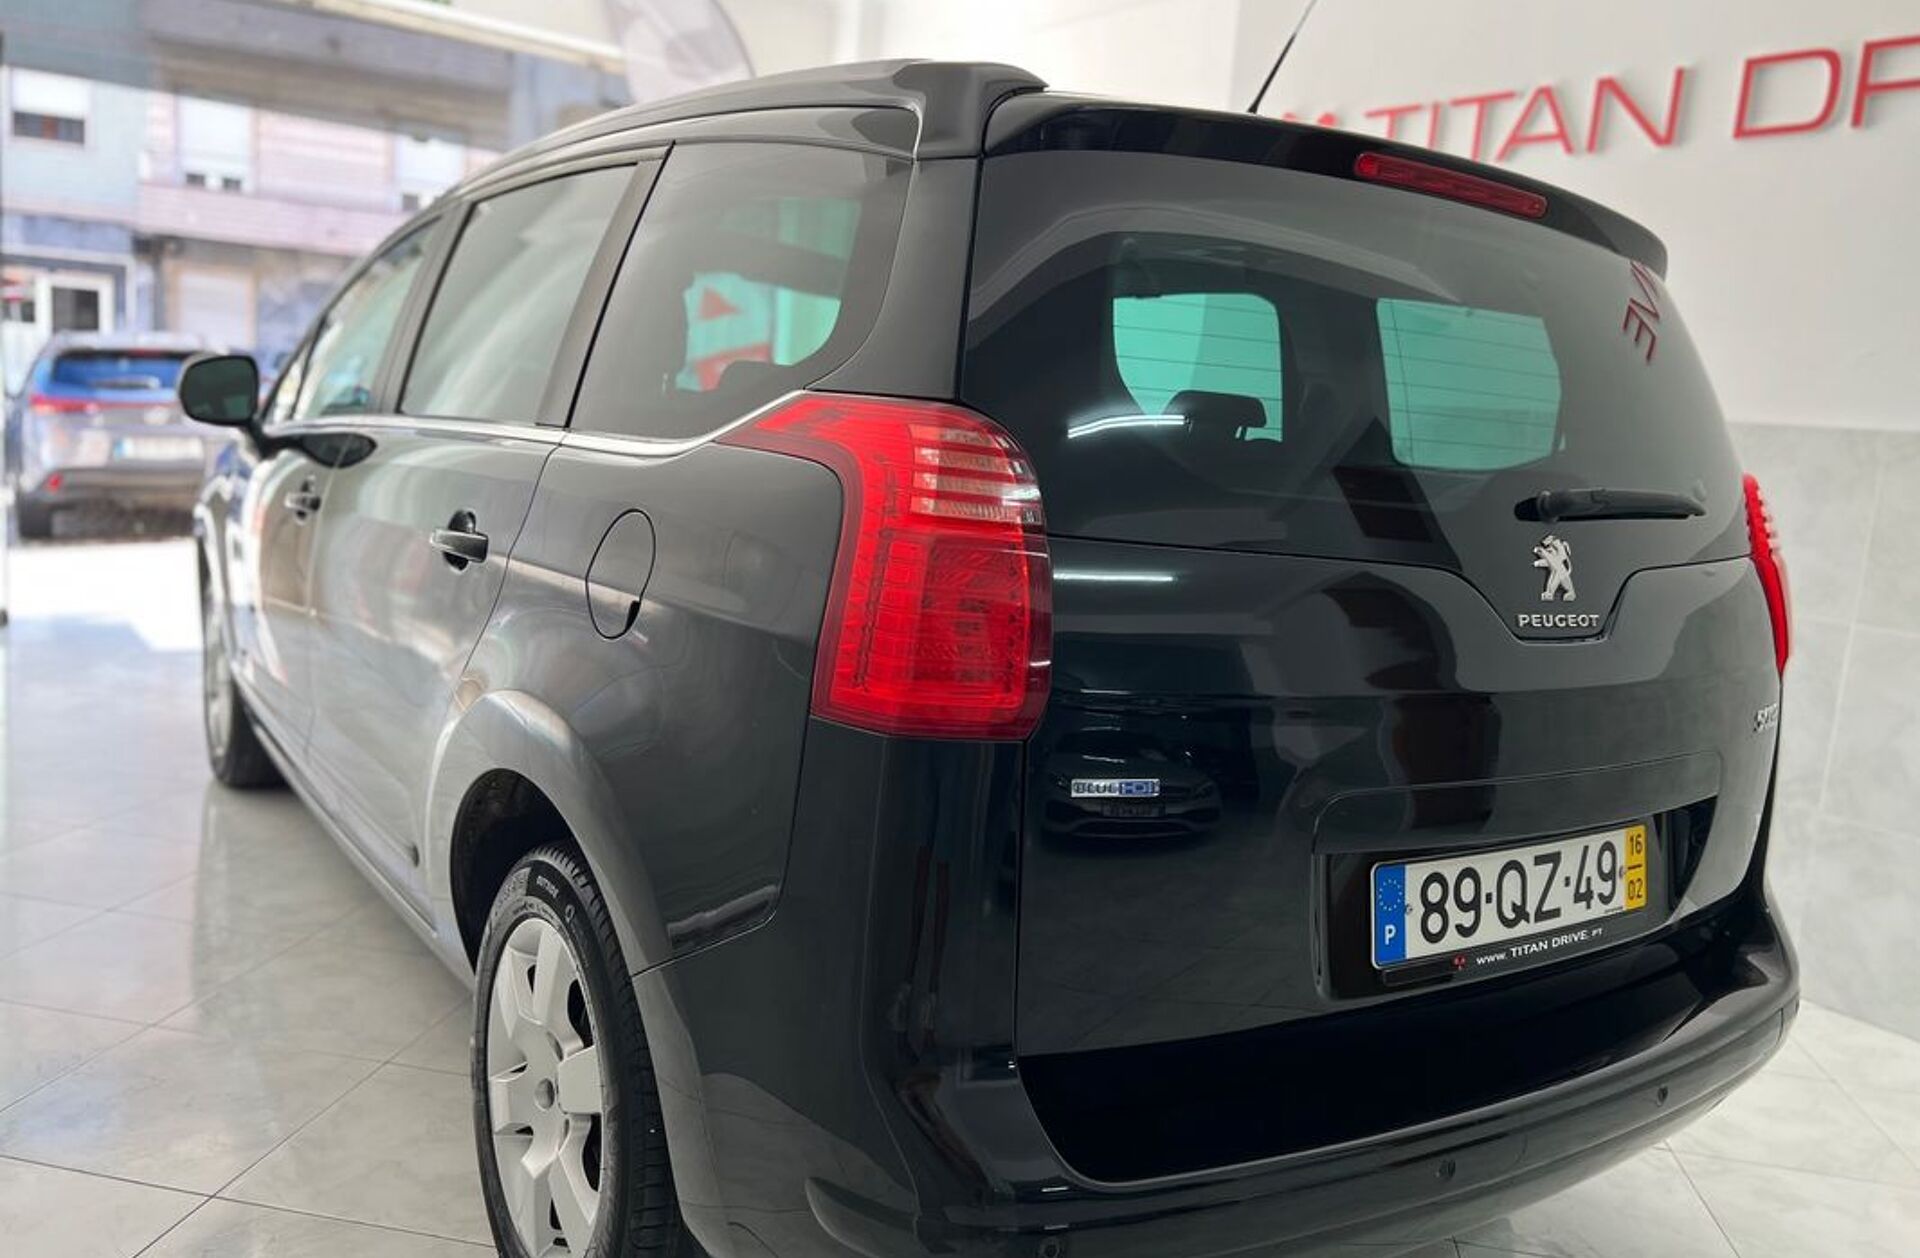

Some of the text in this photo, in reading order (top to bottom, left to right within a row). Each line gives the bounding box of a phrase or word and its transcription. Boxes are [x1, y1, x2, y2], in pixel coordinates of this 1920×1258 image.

[1365, 67, 1689, 162] TITAN
[1518, 614, 1600, 628] PEUGEOT
[1629, 833, 1643, 856] 16
[1628, 878, 1643, 900] 02
[1385, 925, 1397, 945] P
[1510, 940, 1549, 958] TITAN
[1551, 929, 1588, 948] DRIVE
